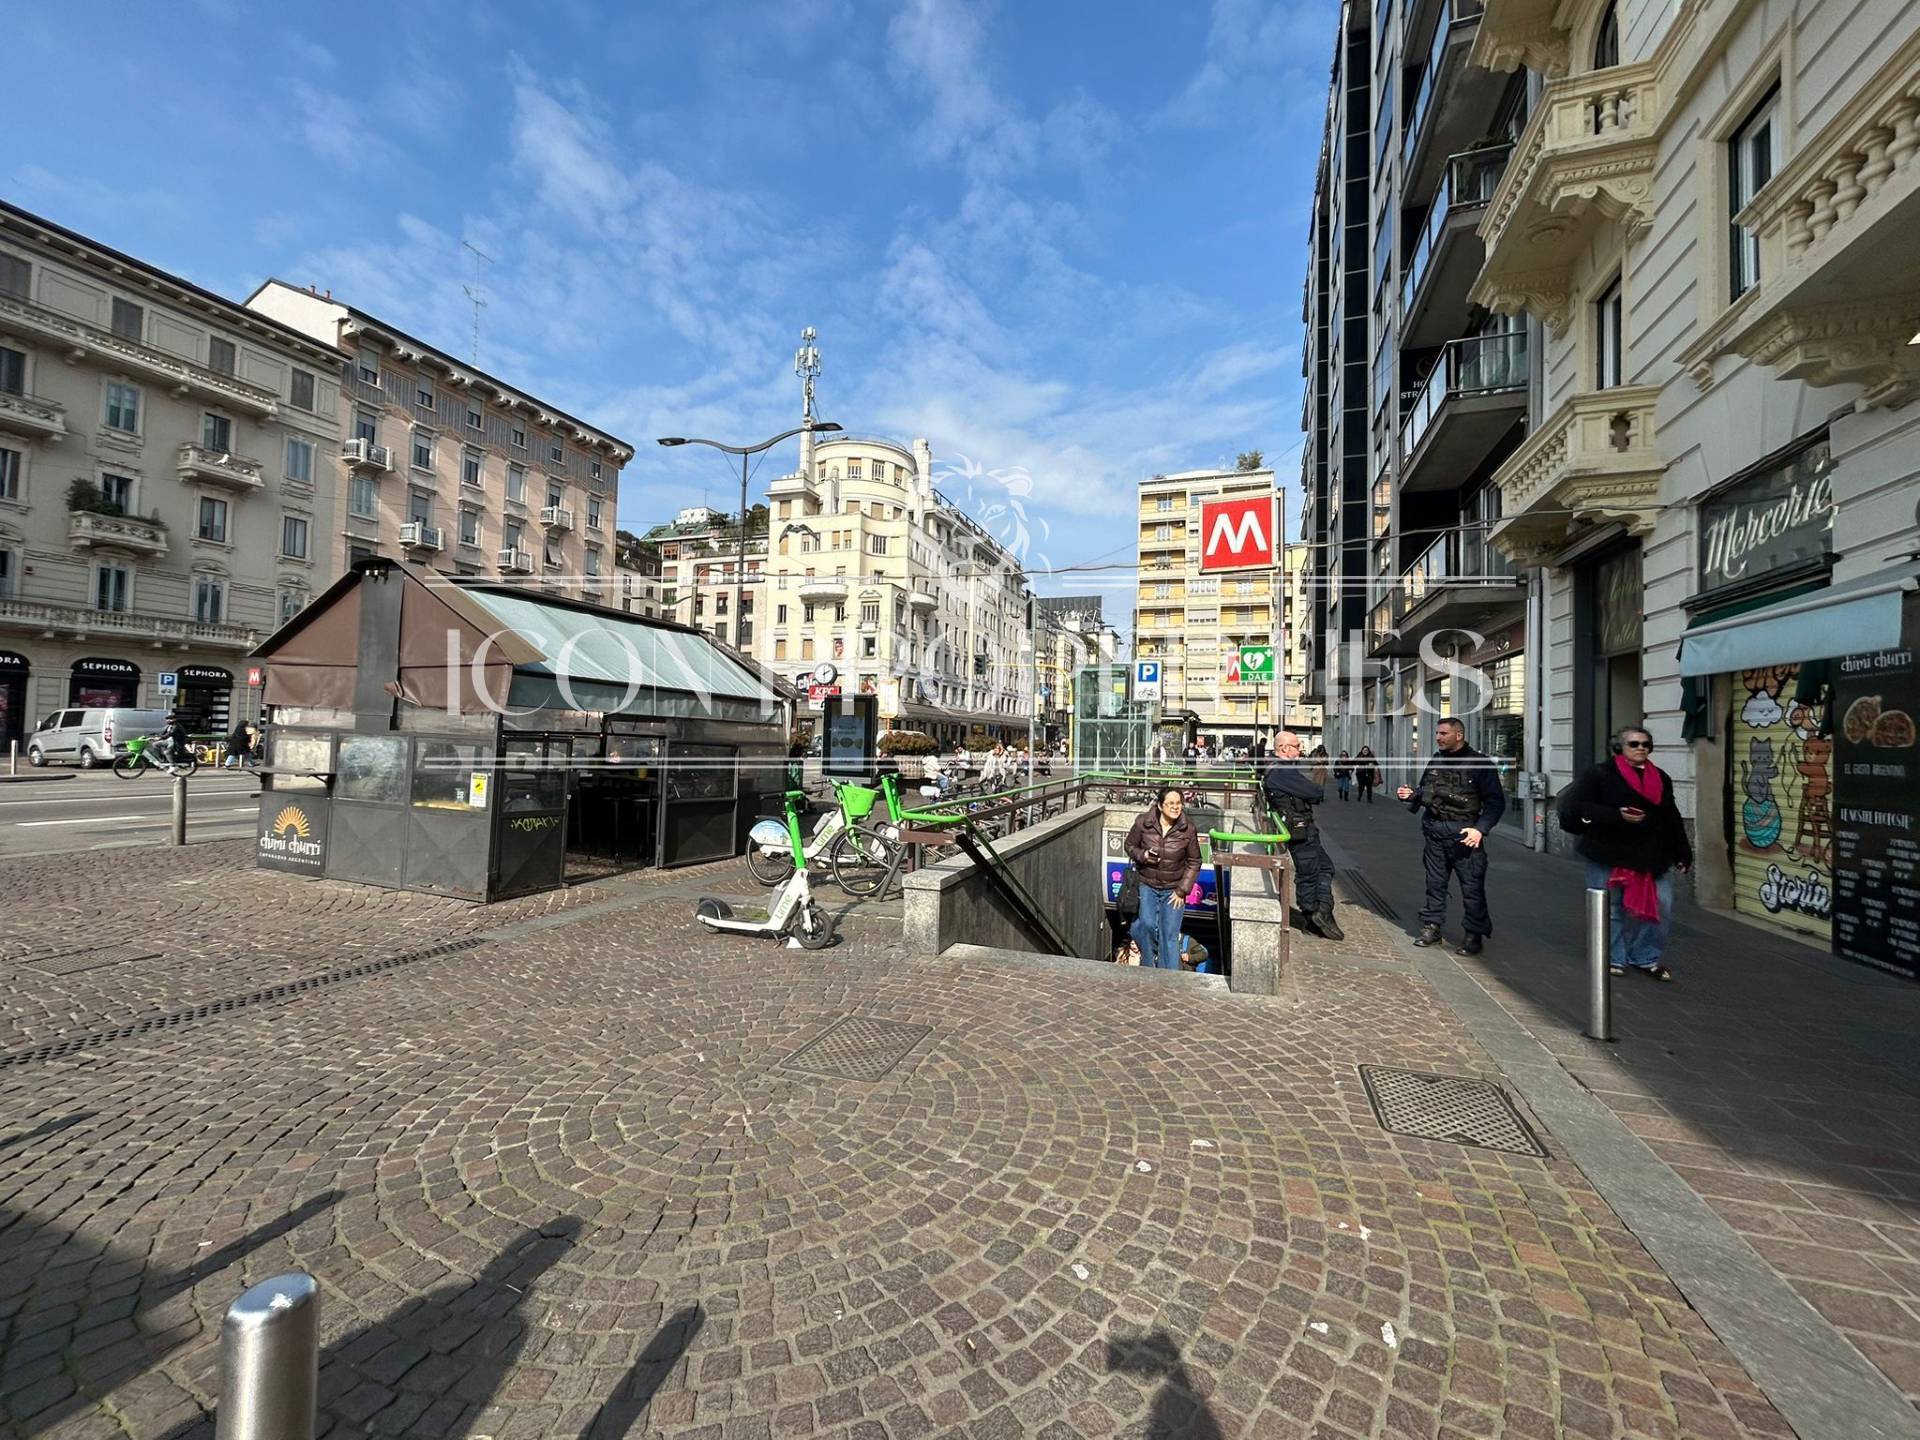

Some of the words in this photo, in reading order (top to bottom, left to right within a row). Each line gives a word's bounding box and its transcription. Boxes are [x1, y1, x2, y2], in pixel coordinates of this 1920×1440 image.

[1205, 511, 1268, 556] M
[82, 661, 133, 672] SEPHORA
[1841, 655, 1871, 672] chimi
[1874, 648, 1912, 668] churri
[184, 669, 228, 678] SEPHORA
[1142, 667, 1155, 680] P
[814, 687, 835, 695] KFC
[260, 830, 286, 850] chimi
[288, 834, 321, 856] churri
